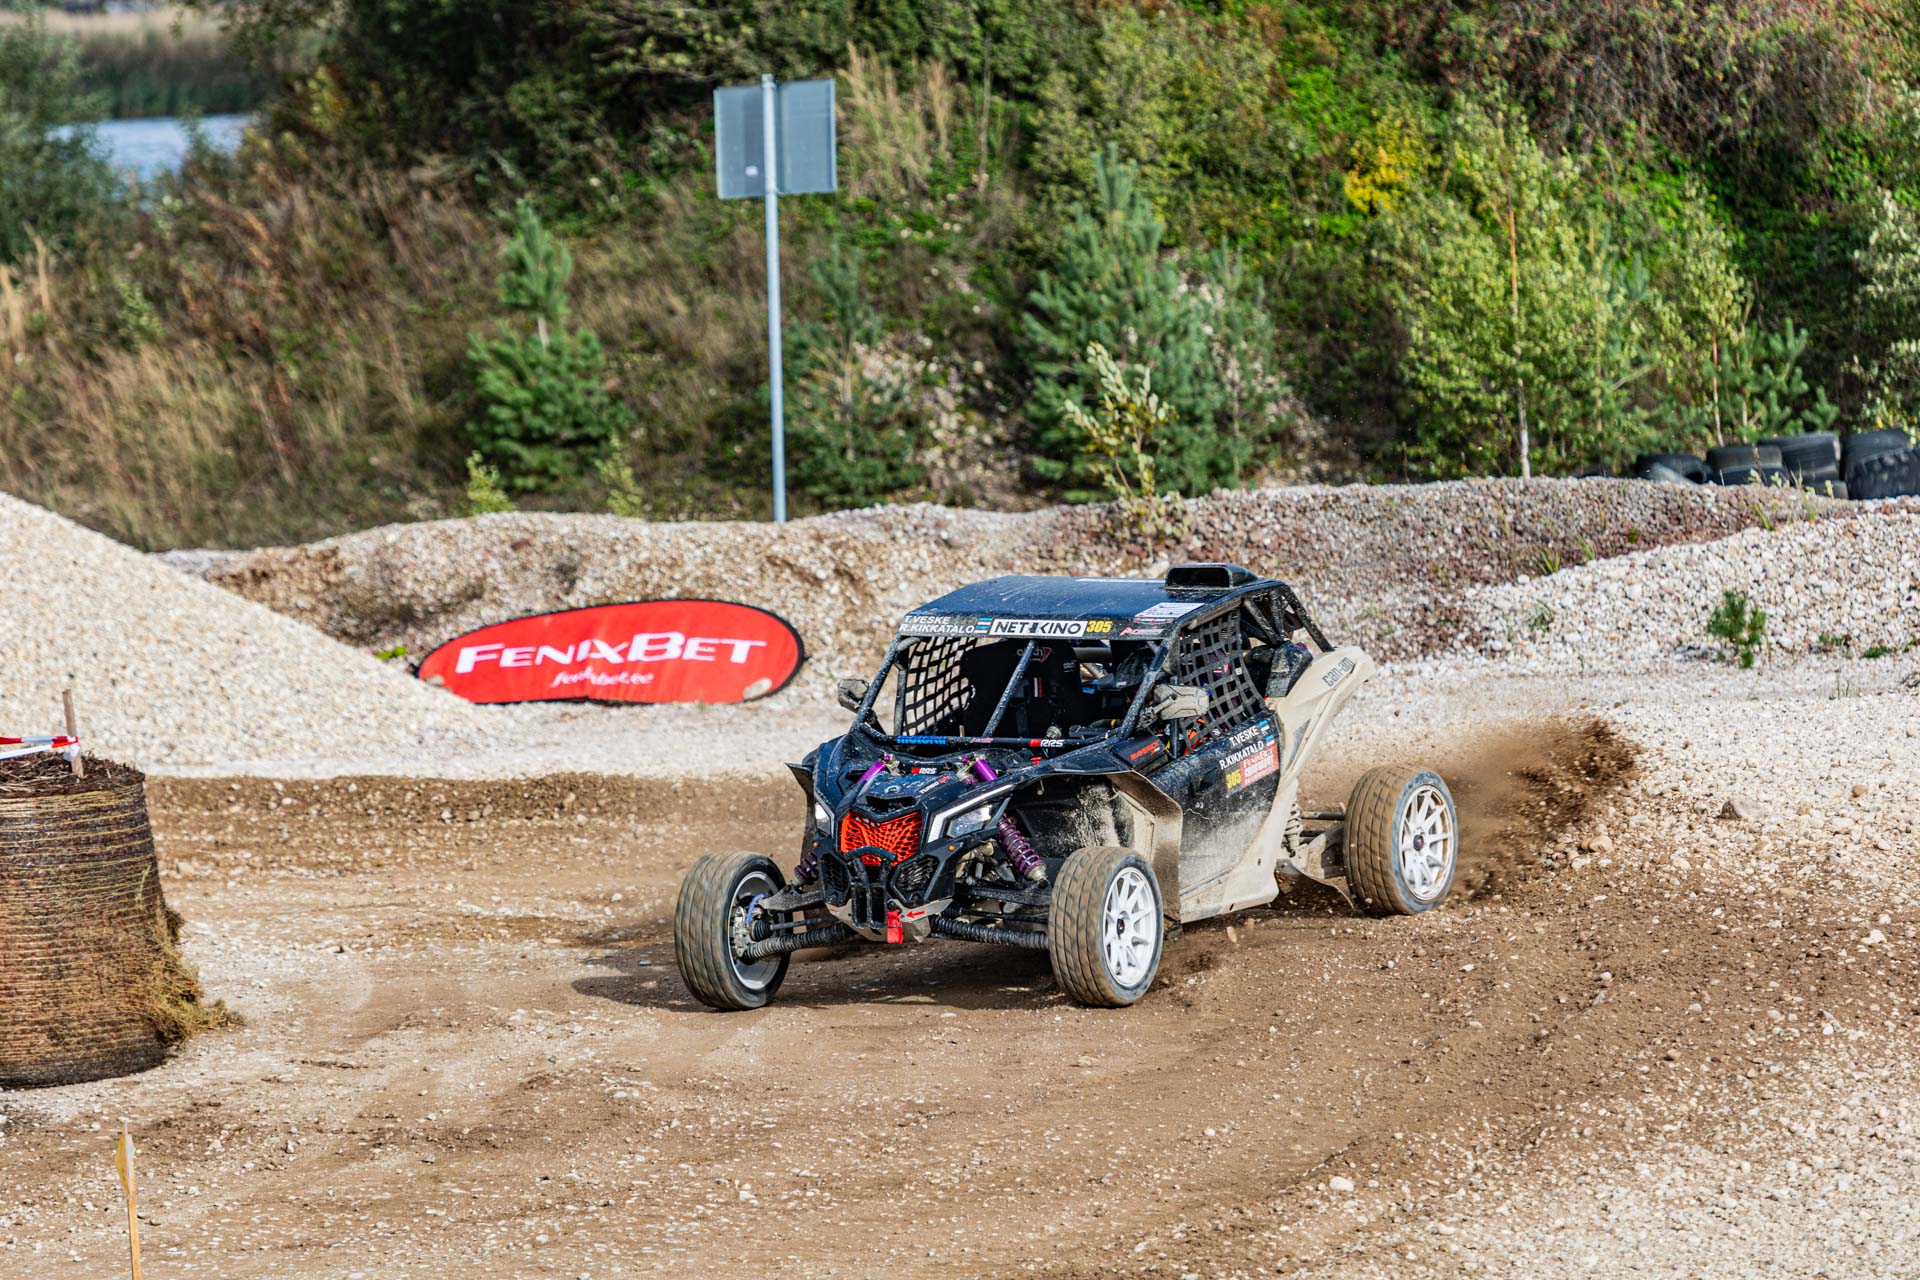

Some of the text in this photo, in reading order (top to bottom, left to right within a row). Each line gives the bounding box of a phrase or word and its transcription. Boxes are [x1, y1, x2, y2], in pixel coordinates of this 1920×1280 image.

[904, 616, 951, 625] T.VESKE
[898, 624, 975, 634] R.KIKKATALO
[1086, 620, 1113, 633] 305
[1229, 725, 1260, 747] T.VESKE
[1040, 739, 1065, 748] RRS
[1218, 740, 1265, 770] R.KIKKATALO
[918, 767, 938, 775] RRS
